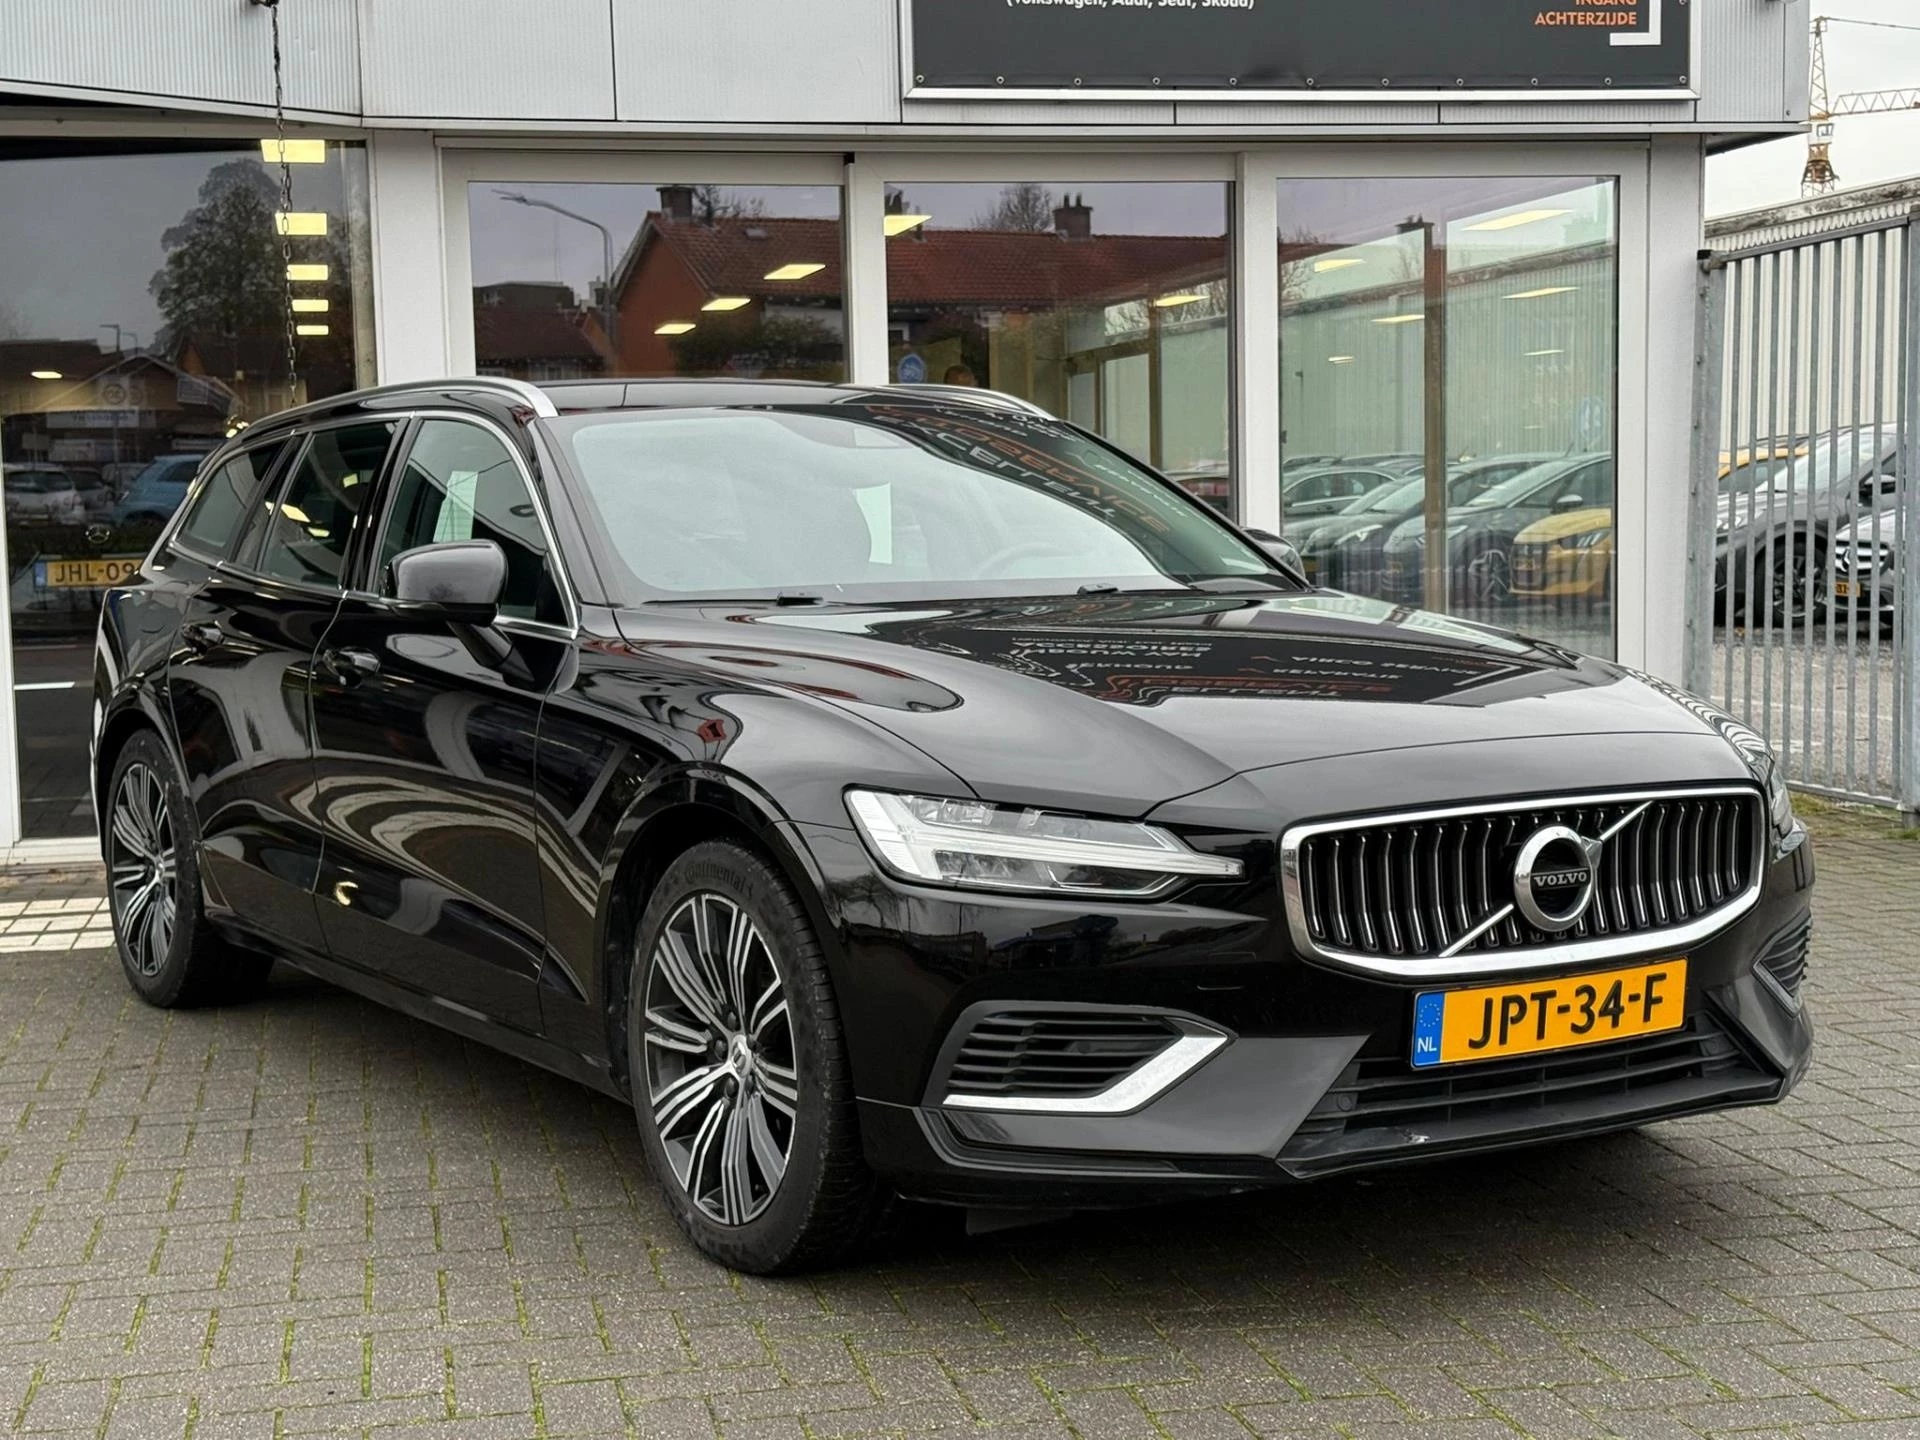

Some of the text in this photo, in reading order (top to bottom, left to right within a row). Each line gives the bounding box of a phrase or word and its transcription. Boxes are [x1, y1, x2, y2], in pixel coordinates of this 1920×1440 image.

[1534, 12, 1638, 26] ACHTERZIJDE
[1533, 871, 1588, 887] VOLVO
[1468, 972, 1667, 1049] JPT-34-F
[1417, 1036, 1438, 1053] NL
